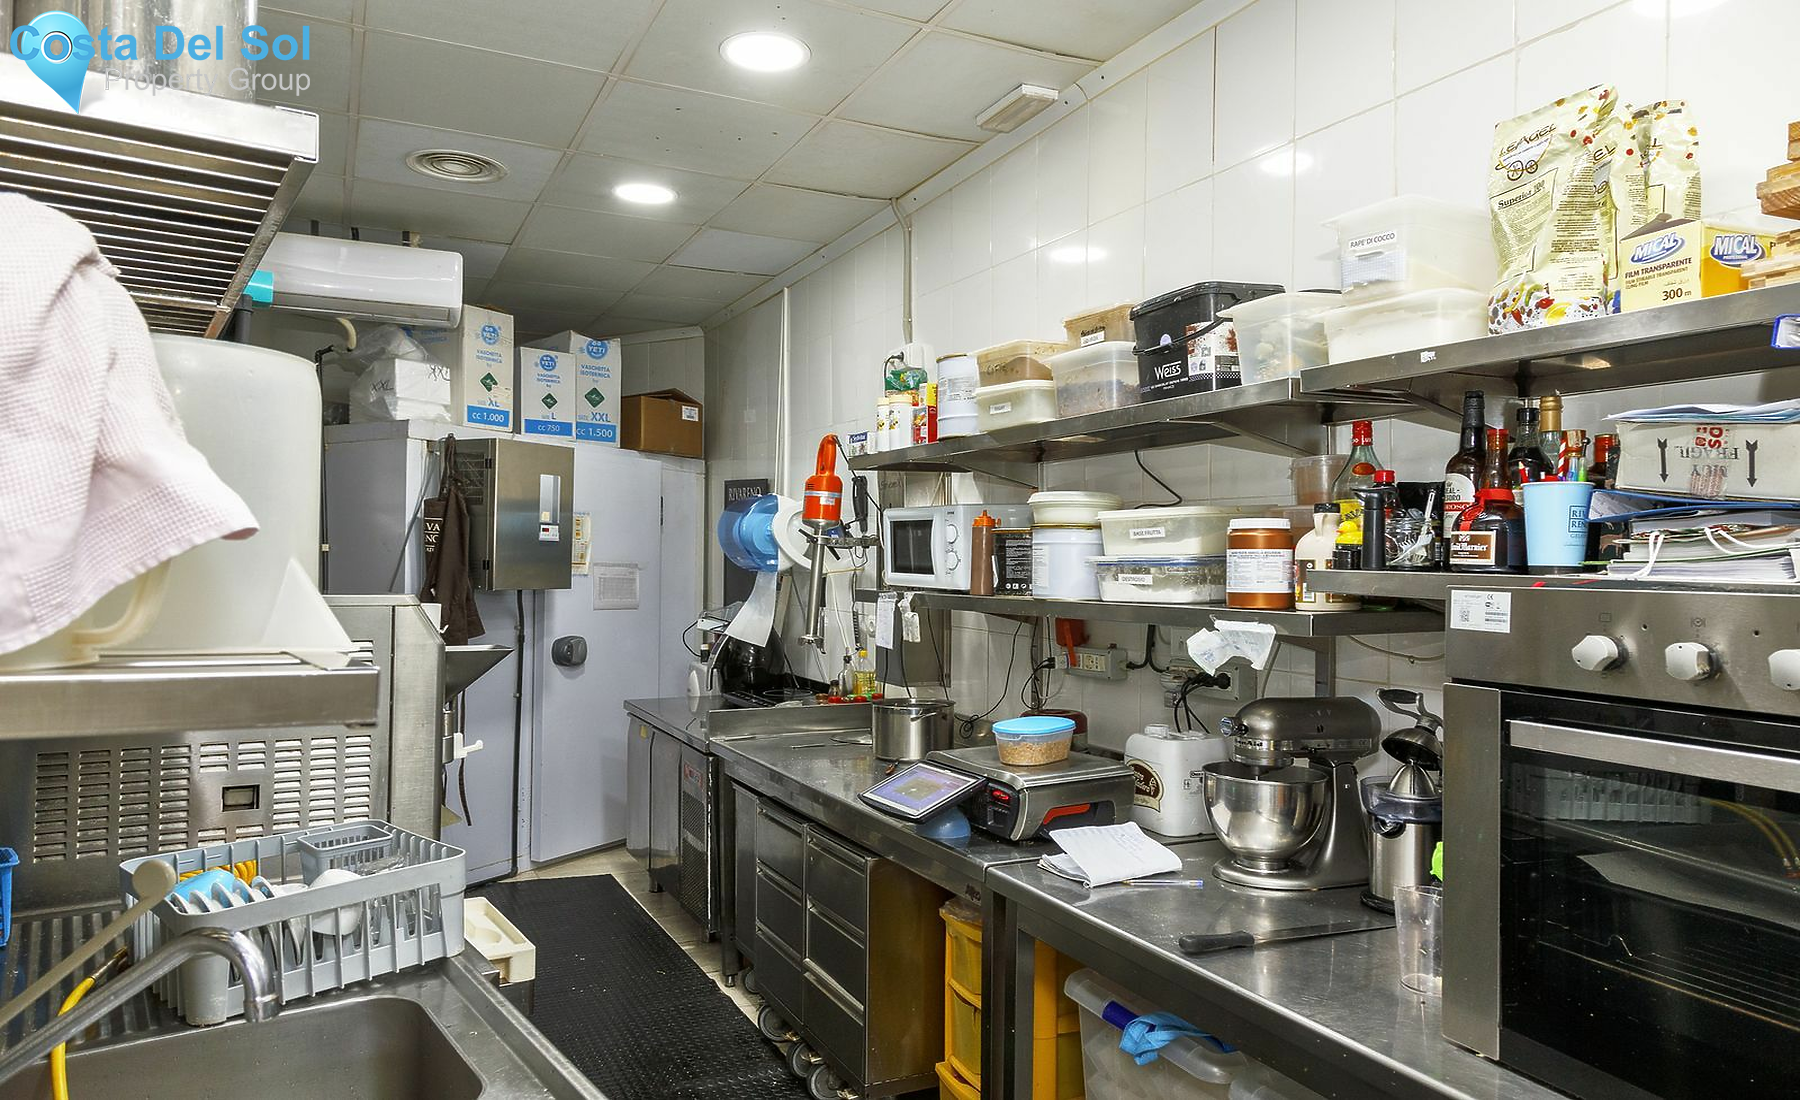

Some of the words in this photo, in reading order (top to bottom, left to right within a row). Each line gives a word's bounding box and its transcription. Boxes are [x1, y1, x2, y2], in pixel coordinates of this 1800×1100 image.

[1497, 189, 1532, 208] Superior
[1373, 232, 1395, 243] COCCO
[1633, 231, 1677, 262] MICAL
[1713, 234, 1758, 256] MICAL
[1624, 268, 1640, 279] FILM
[1640, 256, 1693, 275] TRANSPARENTE
[1662, 287, 1683, 301] 300
[471, 411, 481, 420] cc
[482, 411, 505, 423] 1.000
[590, 412, 611, 422] XXL
[546, 424, 560, 432] 750
[588, 427, 613, 438] 1.500
[425, 522, 441, 532] VA
